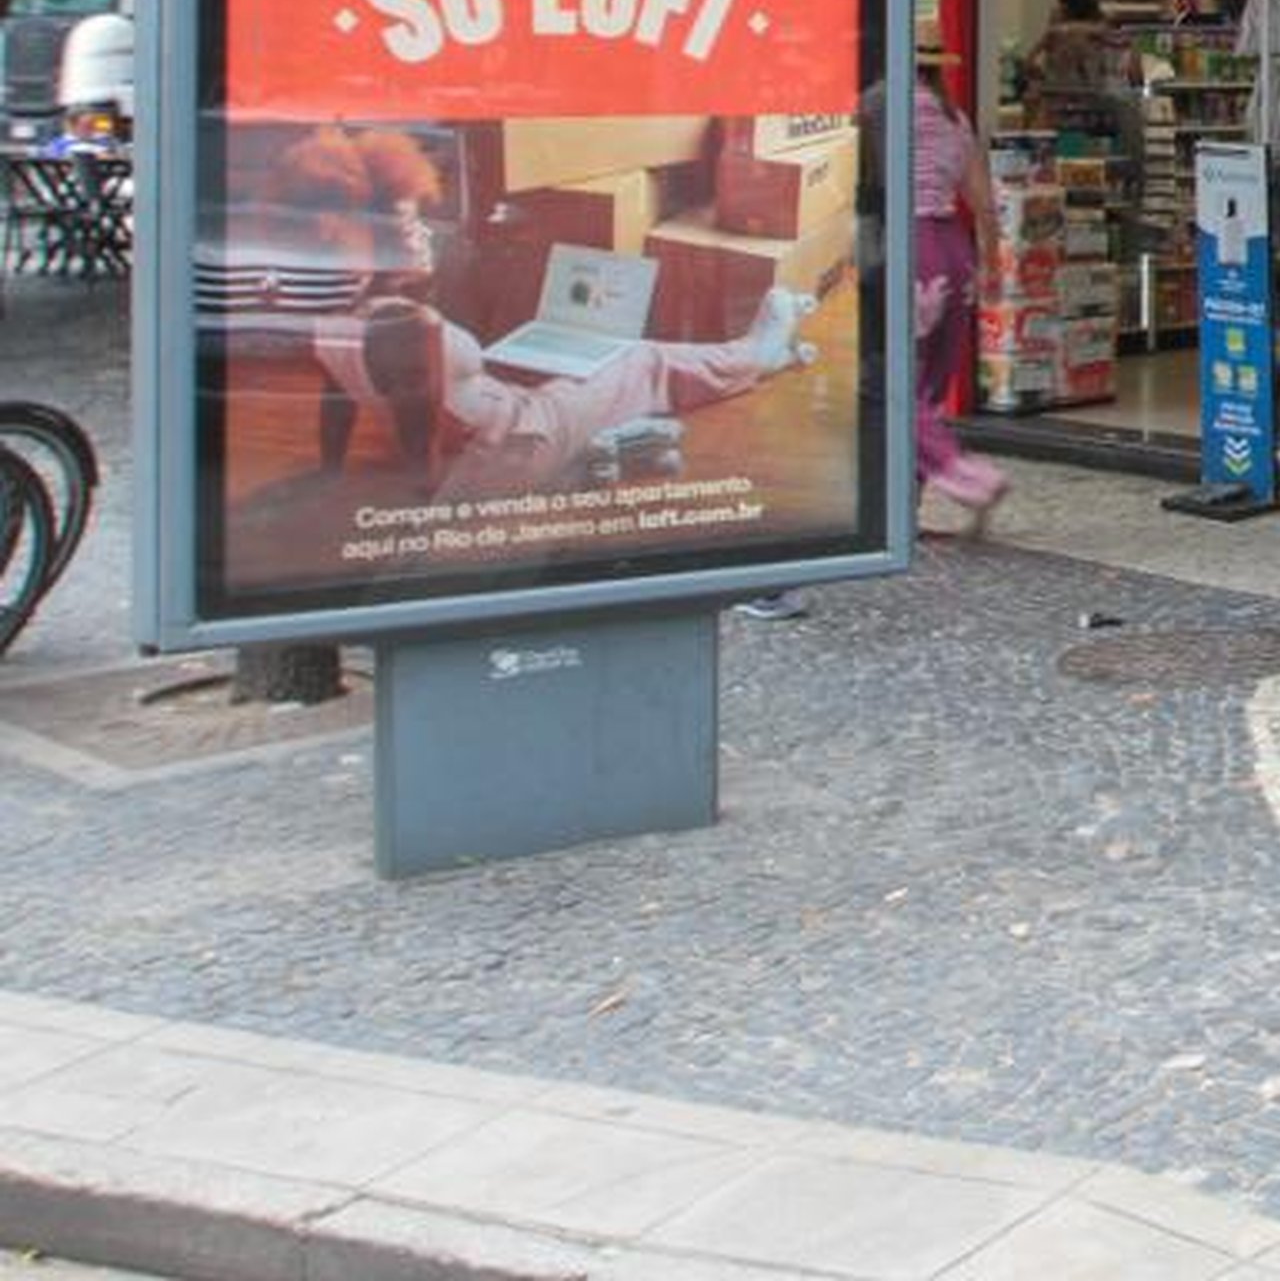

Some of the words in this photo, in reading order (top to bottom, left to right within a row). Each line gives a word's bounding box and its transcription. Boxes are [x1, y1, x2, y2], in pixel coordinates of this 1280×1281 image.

[341, 533, 395, 561] aqui
[400, 535, 429, 552] no
[433, 528, 473, 551] Rio
[476, 525, 508, 547] de
[510, 517, 595, 543] Janeiro
[599, 516, 634, 535] em
[639, 501, 763, 529] loft.com.br
[355, 505, 453, 531] Compre
[456, 502, 473, 519] e
[475, 493, 548, 516] venda
[551, 493, 567, 510] o
[571, 491, 611, 508] seu
[614, 476, 752, 509] apartamento
